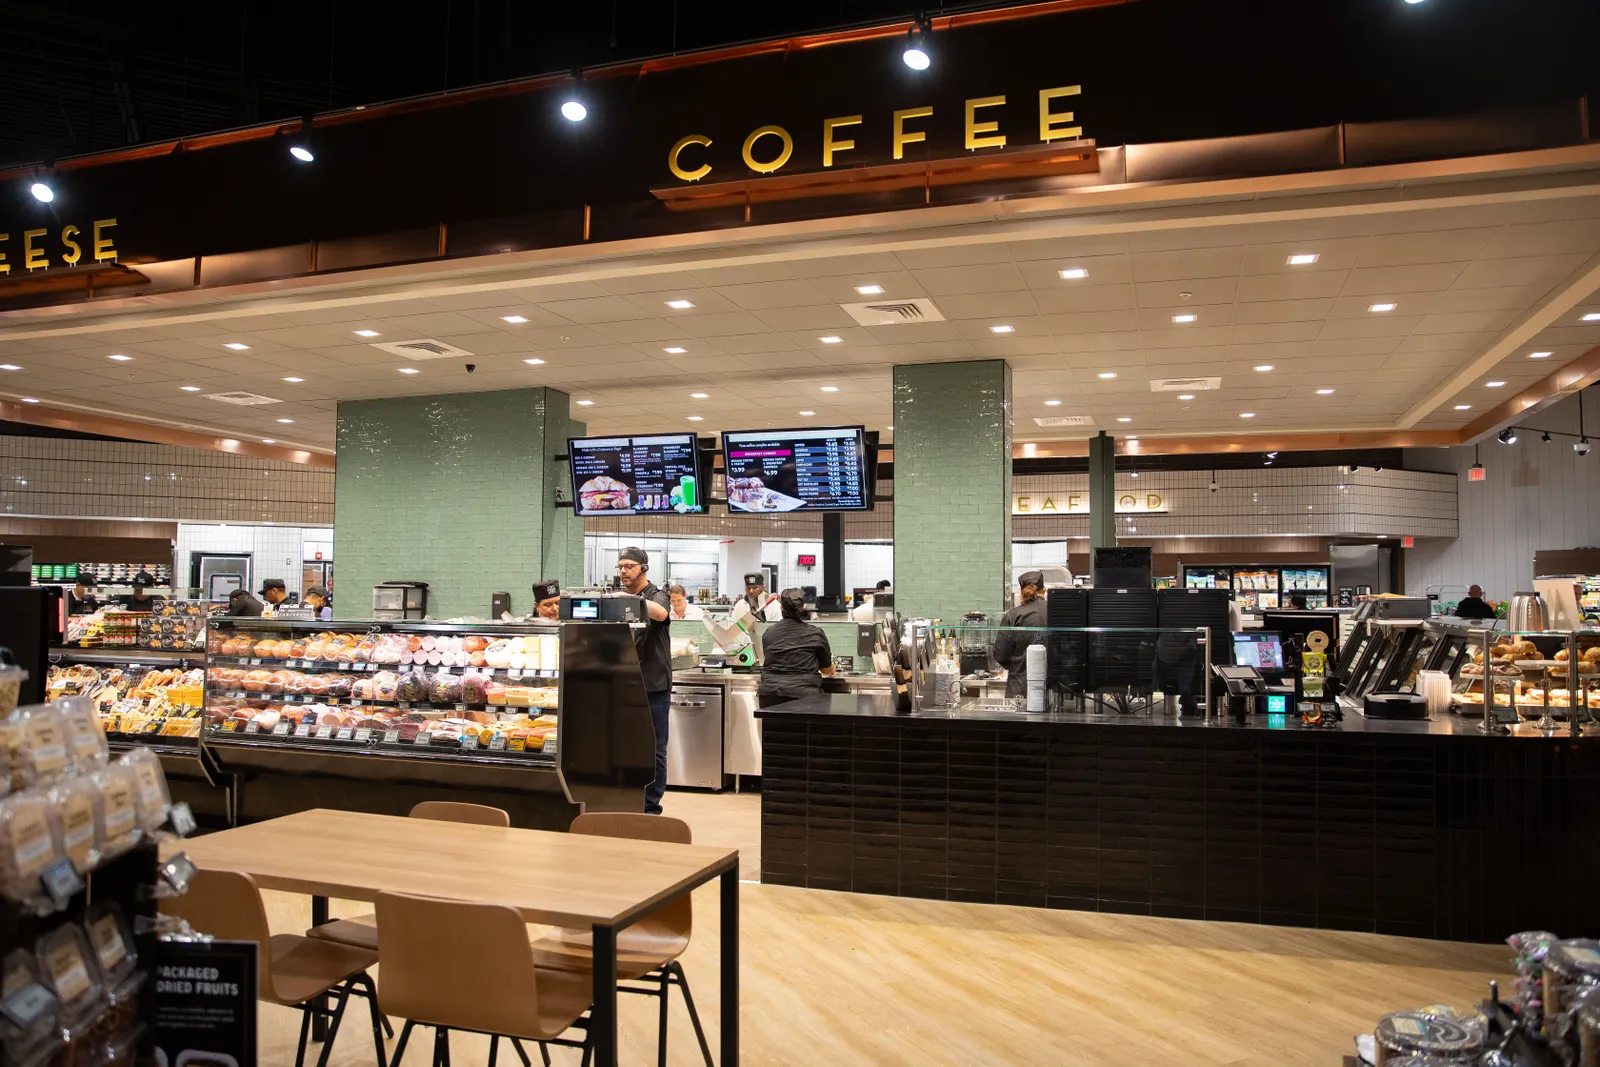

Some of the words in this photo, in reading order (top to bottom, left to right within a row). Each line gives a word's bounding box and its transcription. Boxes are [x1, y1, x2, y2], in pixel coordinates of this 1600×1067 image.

[668, 85, 1082, 181] COFFEE
[1017, 493, 1163, 512] EAFOD
[157, 965, 219, 981] PACKAGED
[156, 980, 193, 994] DRIED
[195, 982, 239, 996] FRUITS
